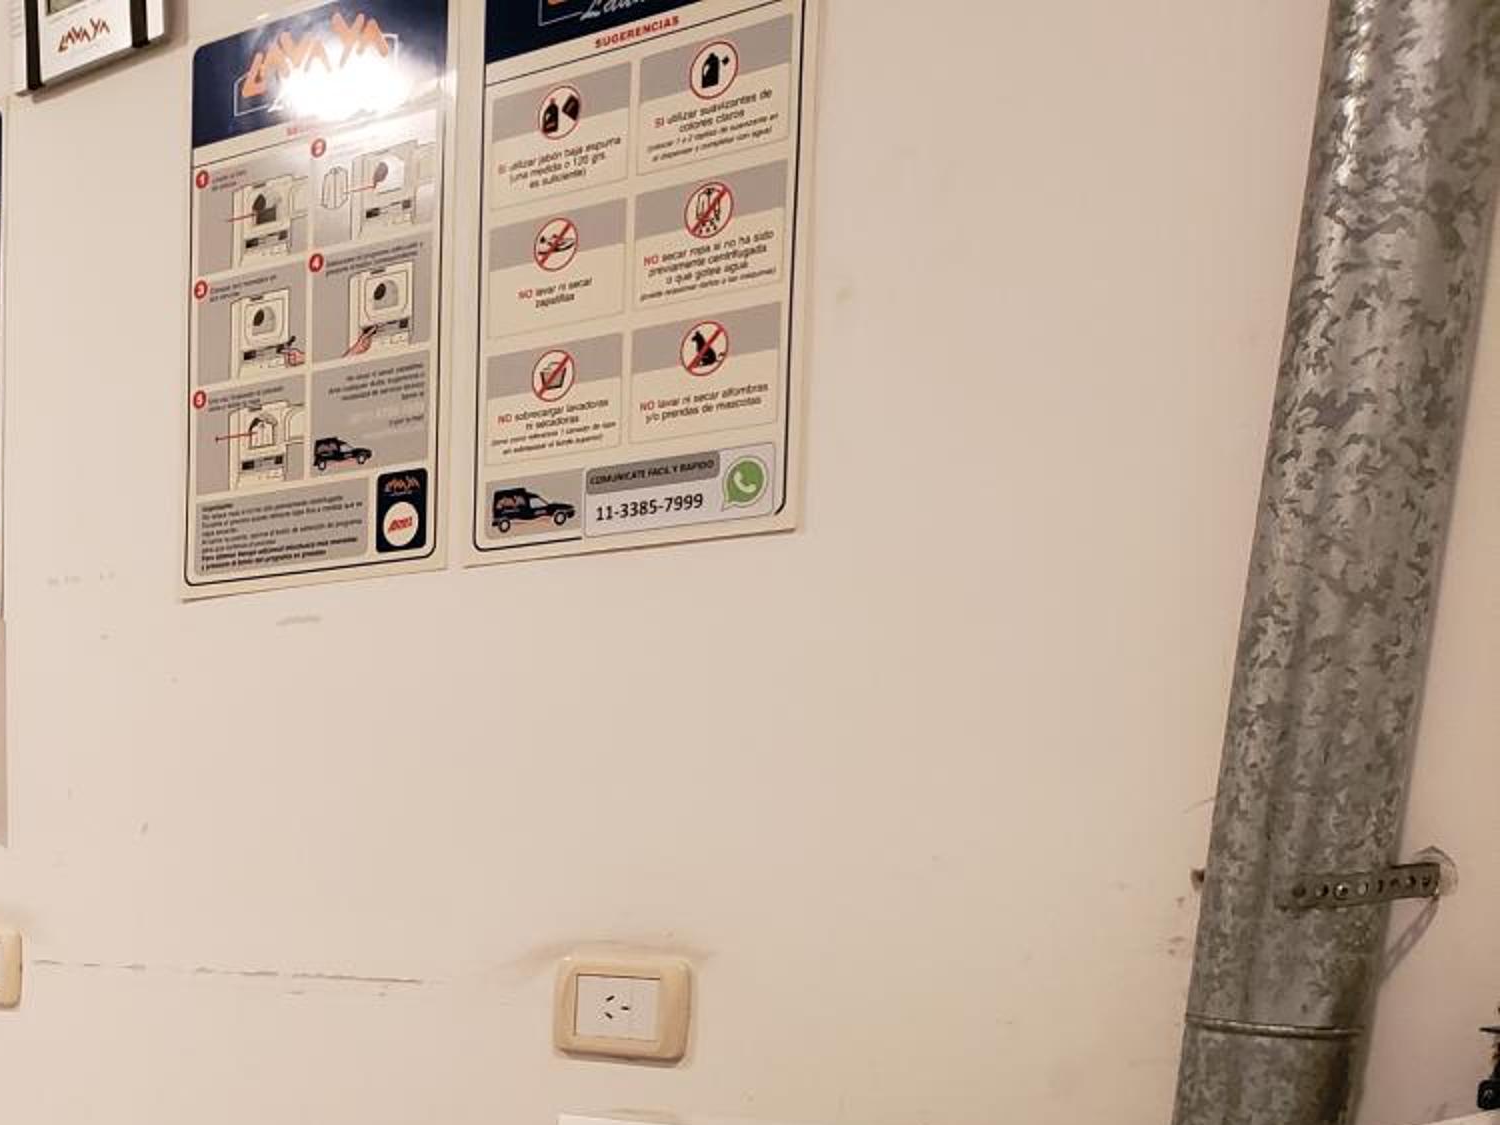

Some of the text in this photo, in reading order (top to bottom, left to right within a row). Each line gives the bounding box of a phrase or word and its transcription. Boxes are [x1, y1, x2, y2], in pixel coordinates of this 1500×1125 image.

[58, 18, 111, 52] LAVAYA
[595, 16, 680, 47] SUGERENCIAS
[644, 255, 660, 267] NO
[662, 250, 687, 262] secar
[723, 239, 736, 249] no
[640, 400, 655, 411] NO
[658, 397, 680, 409] lavar
[693, 391, 719, 402] secar
[722, 384, 768, 398] alfombras
[662, 406, 699, 421] prendas
[701, 403, 714, 413] de
[589, 469, 646, 486] COMUNICATE
[679, 459, 715, 473] RAPIDO
[596, 493, 704, 521] 11-3385-7999
